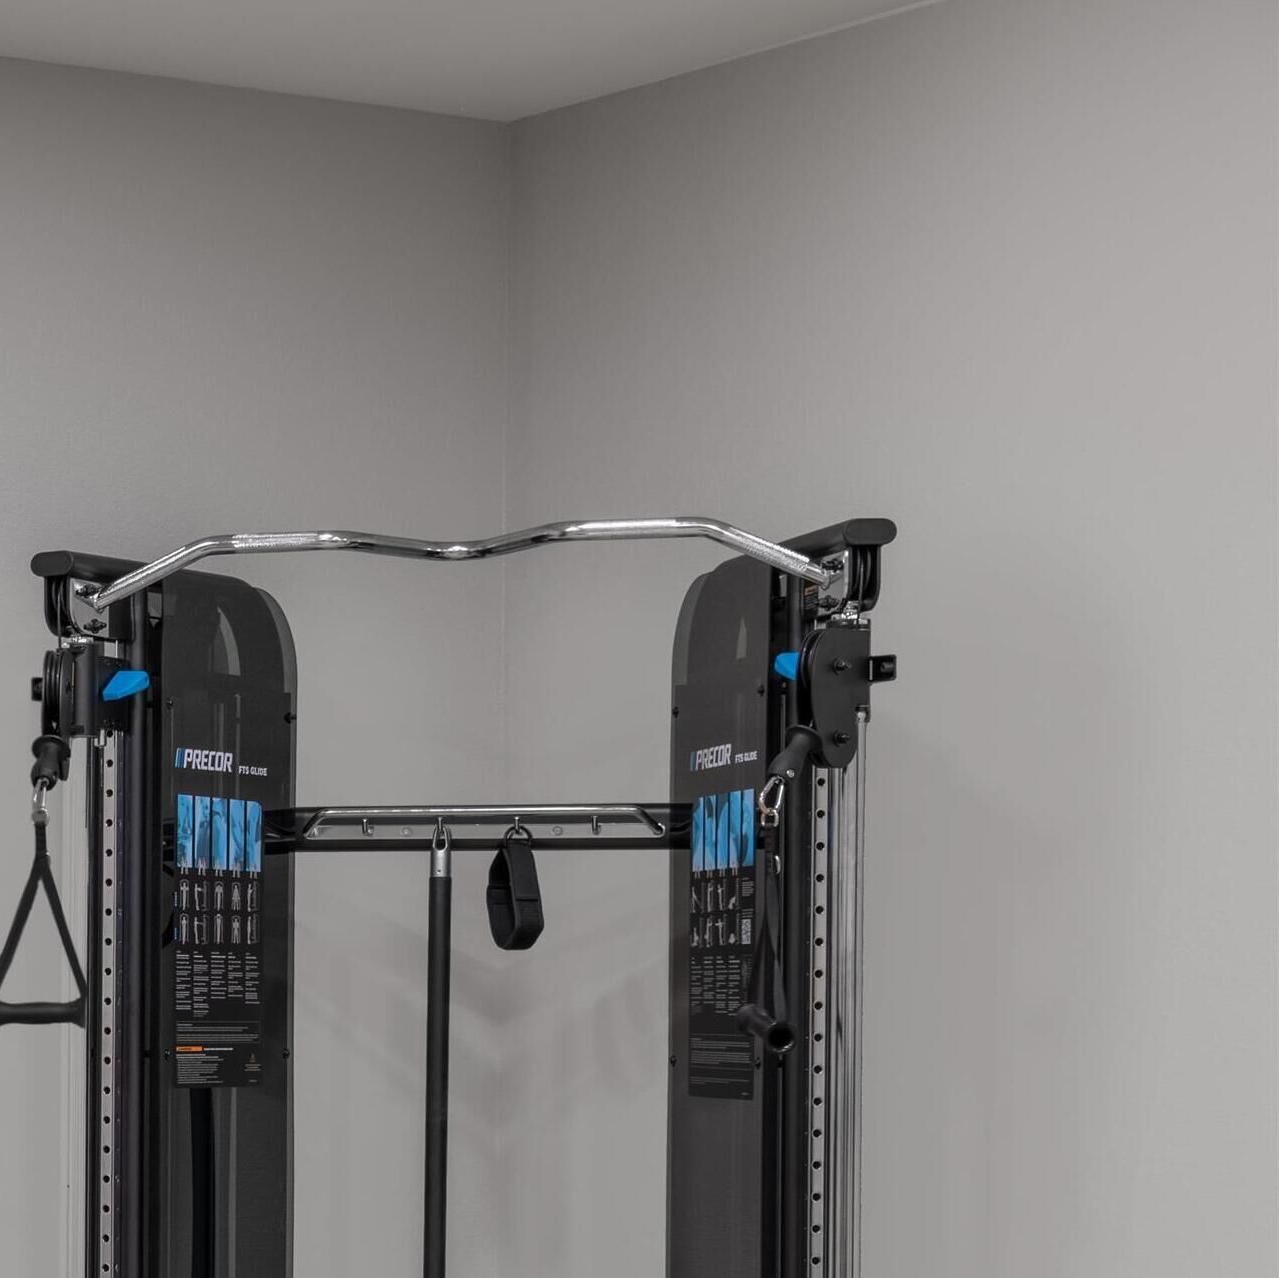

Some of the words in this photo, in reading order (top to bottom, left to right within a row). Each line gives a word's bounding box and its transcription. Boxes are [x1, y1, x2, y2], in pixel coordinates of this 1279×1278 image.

[183, 748, 234, 773] PRECOR
[238, 765, 249, 775] FTS
[250, 766, 268, 777] GLIDE
[695, 743, 732, 771] PRECOR
